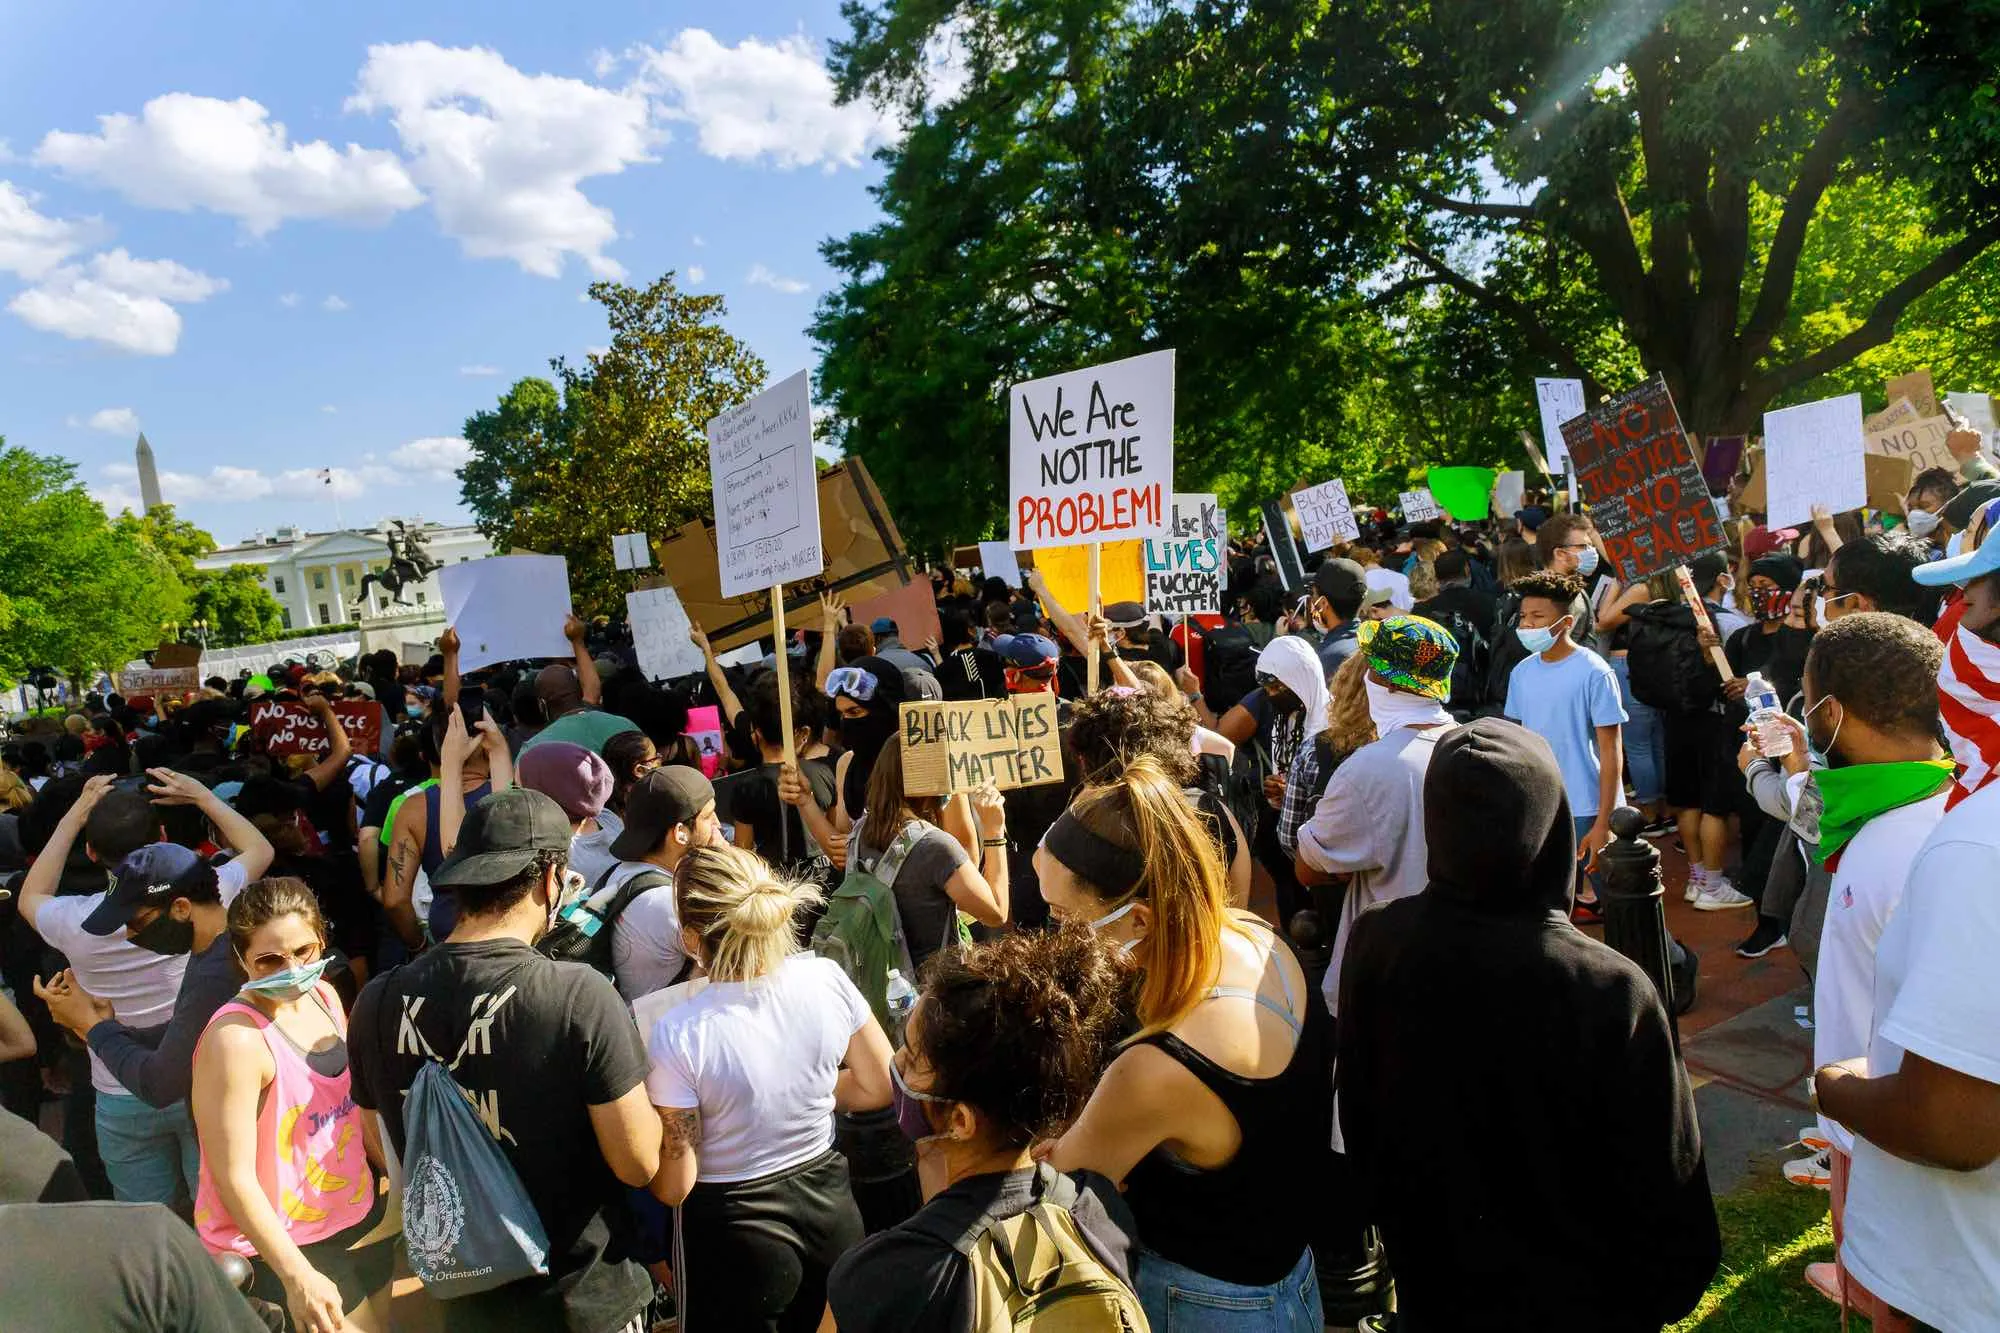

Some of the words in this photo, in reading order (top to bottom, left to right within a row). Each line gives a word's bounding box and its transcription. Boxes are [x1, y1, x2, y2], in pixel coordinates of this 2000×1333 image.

[1022, 386, 1077, 442] We
[1086, 380, 1138, 435] Are
[1591, 403, 1650, 452] NO
[1880, 429, 1918, 456] NO
[1579, 432, 1694, 503] JUSTICE
[1295, 481, 1346, 511] BLACK
[1301, 498, 1350, 526] LIVES
[1624, 477, 1681, 525] NO
[1018, 482, 1162, 544] PROBLEM!
[1172, 502, 1219, 539] LacK
[1303, 516, 1355, 544] MATTER
[1604, 499, 1719, 583] PEACE
[1147, 573, 1219, 597] FUCKING
[1148, 593, 1220, 612] MATTER
[254, 703, 286, 724] NO
[905, 709, 973, 747] BLACK
[984, 704, 1050, 741] LIVES
[268, 729, 295, 752] NO
[949, 745, 1053, 790] MATTER
[435, 1265, 493, 1281] Orientation
